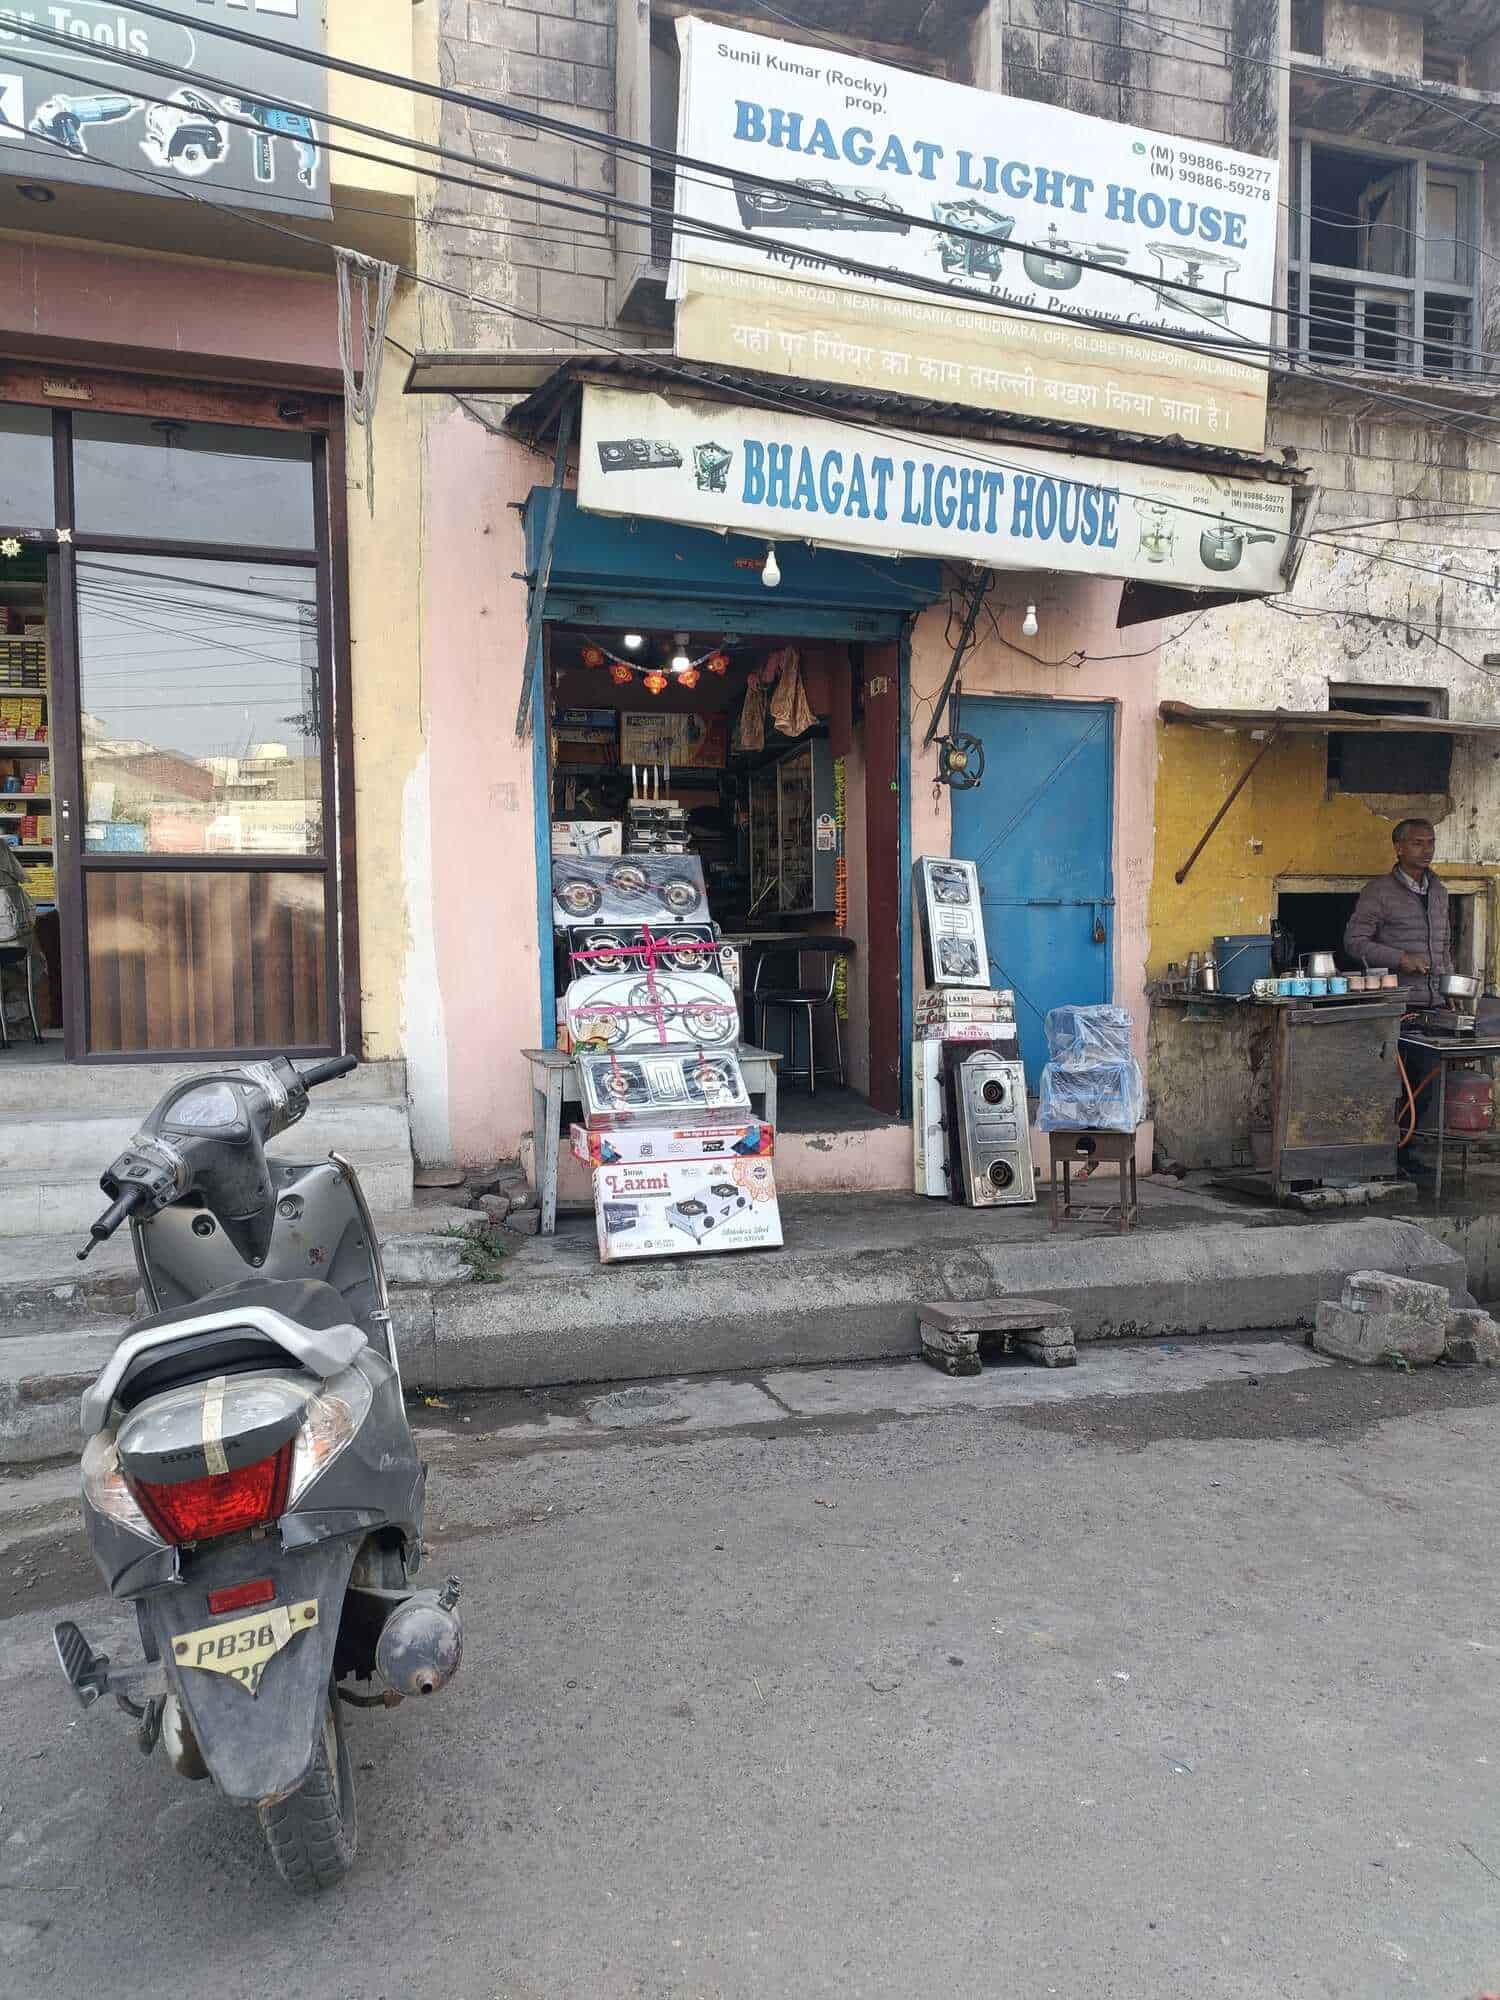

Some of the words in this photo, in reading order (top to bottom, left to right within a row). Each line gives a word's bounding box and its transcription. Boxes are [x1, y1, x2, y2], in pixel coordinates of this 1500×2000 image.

[48, 7, 149, 57] Tools
[717, 43, 761, 66] Sunil
[766, 54, 821, 80] Kumar
[826, 69, 887, 98] (Rocky)
[845, 94, 887, 115] prop.
[733, 100, 944, 181] BHAGAT
[955, 150, 1095, 214] LIGHT
[1105, 184, 1248, 249] HOUSE
[1150, 144, 1175, 164] (M)
[1179, 152, 1271, 184] 99886-59277
[1150, 162, 1174, 180] (M)
[1178, 169, 1270, 201] 99886-59278
[1047, 295, 1121, 321] Pressure
[879, 350, 913, 377] का
[917, 357, 964, 385] काम
[1101, 381, 1155, 416] किया
[1159, 396, 1201, 425] जाता
[742, 439, 894, 520] BHAGAT
[901, 460, 1004, 534] LIGHT
[1010, 474, 1120, 550] HOUSE
[605, 1173, 670, 1194] Laxmi
